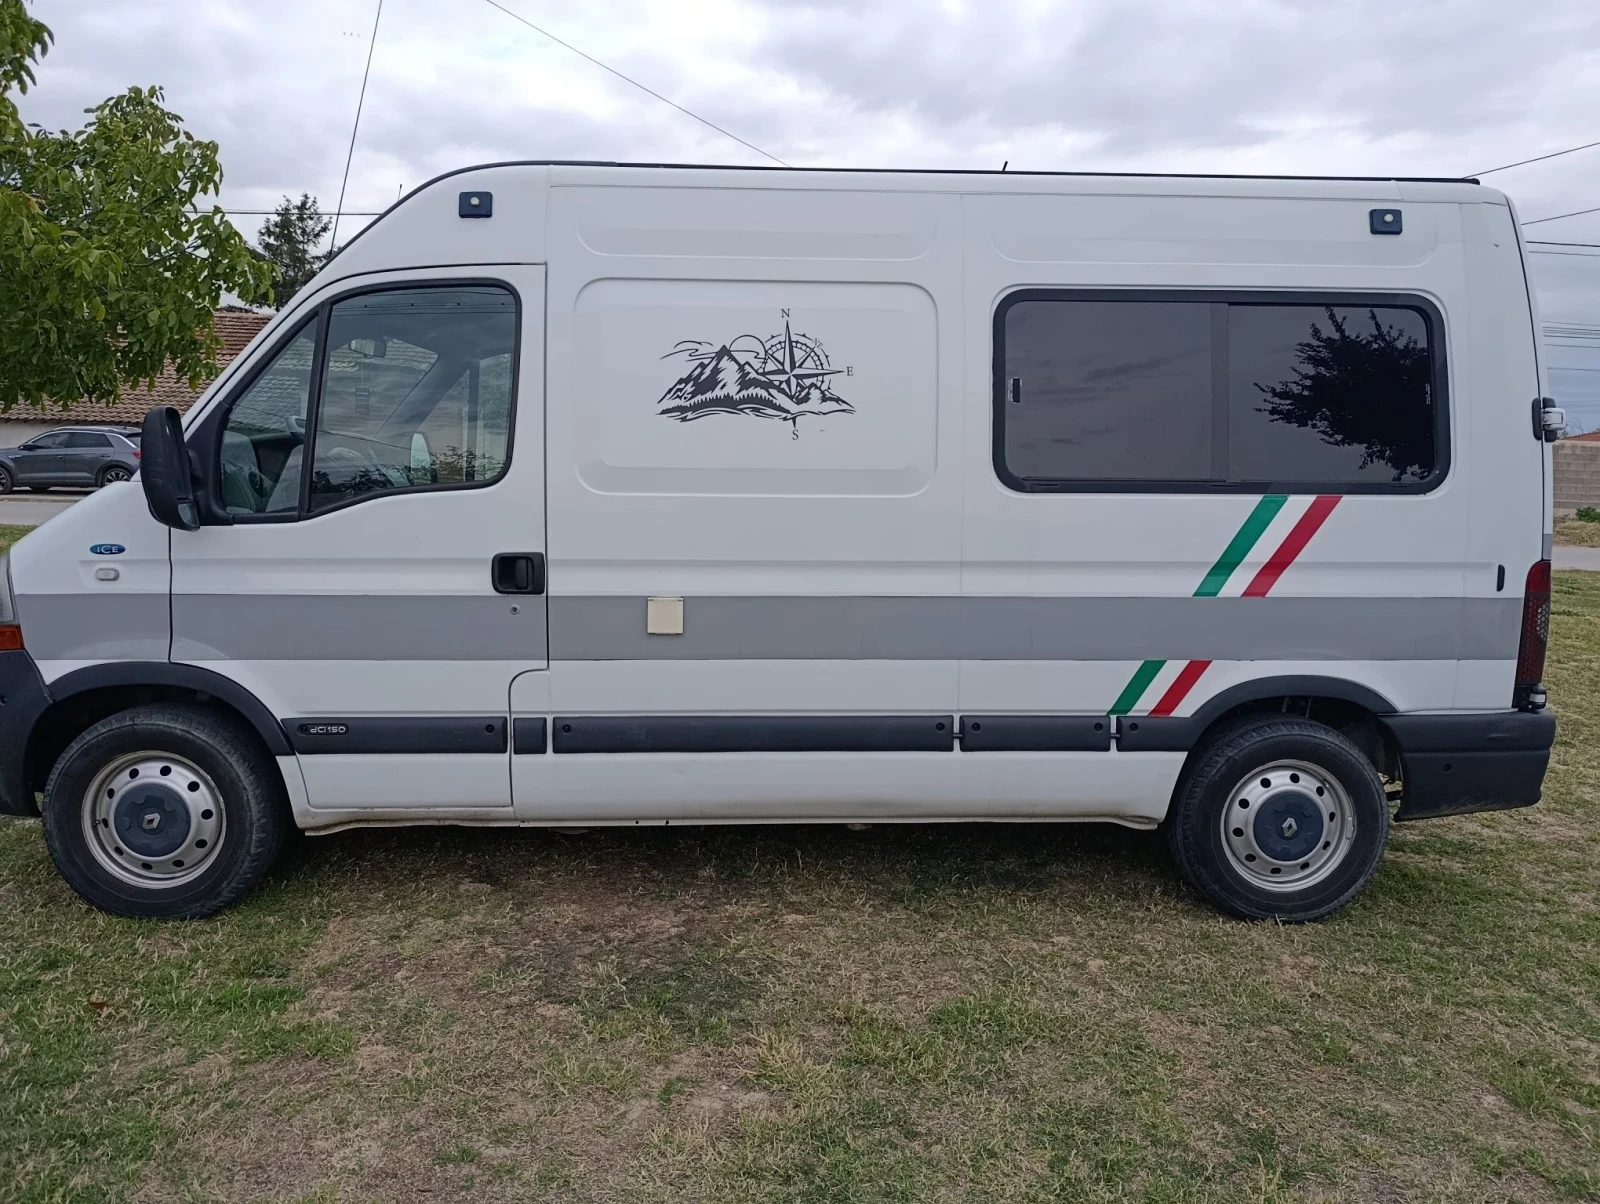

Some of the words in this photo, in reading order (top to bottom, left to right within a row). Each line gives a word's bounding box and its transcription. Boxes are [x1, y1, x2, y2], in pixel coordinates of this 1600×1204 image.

[781, 308, 791, 318] N
[846, 366, 854, 376] E
[791, 429, 799, 441] S
[97, 545, 119, 554] ICE
